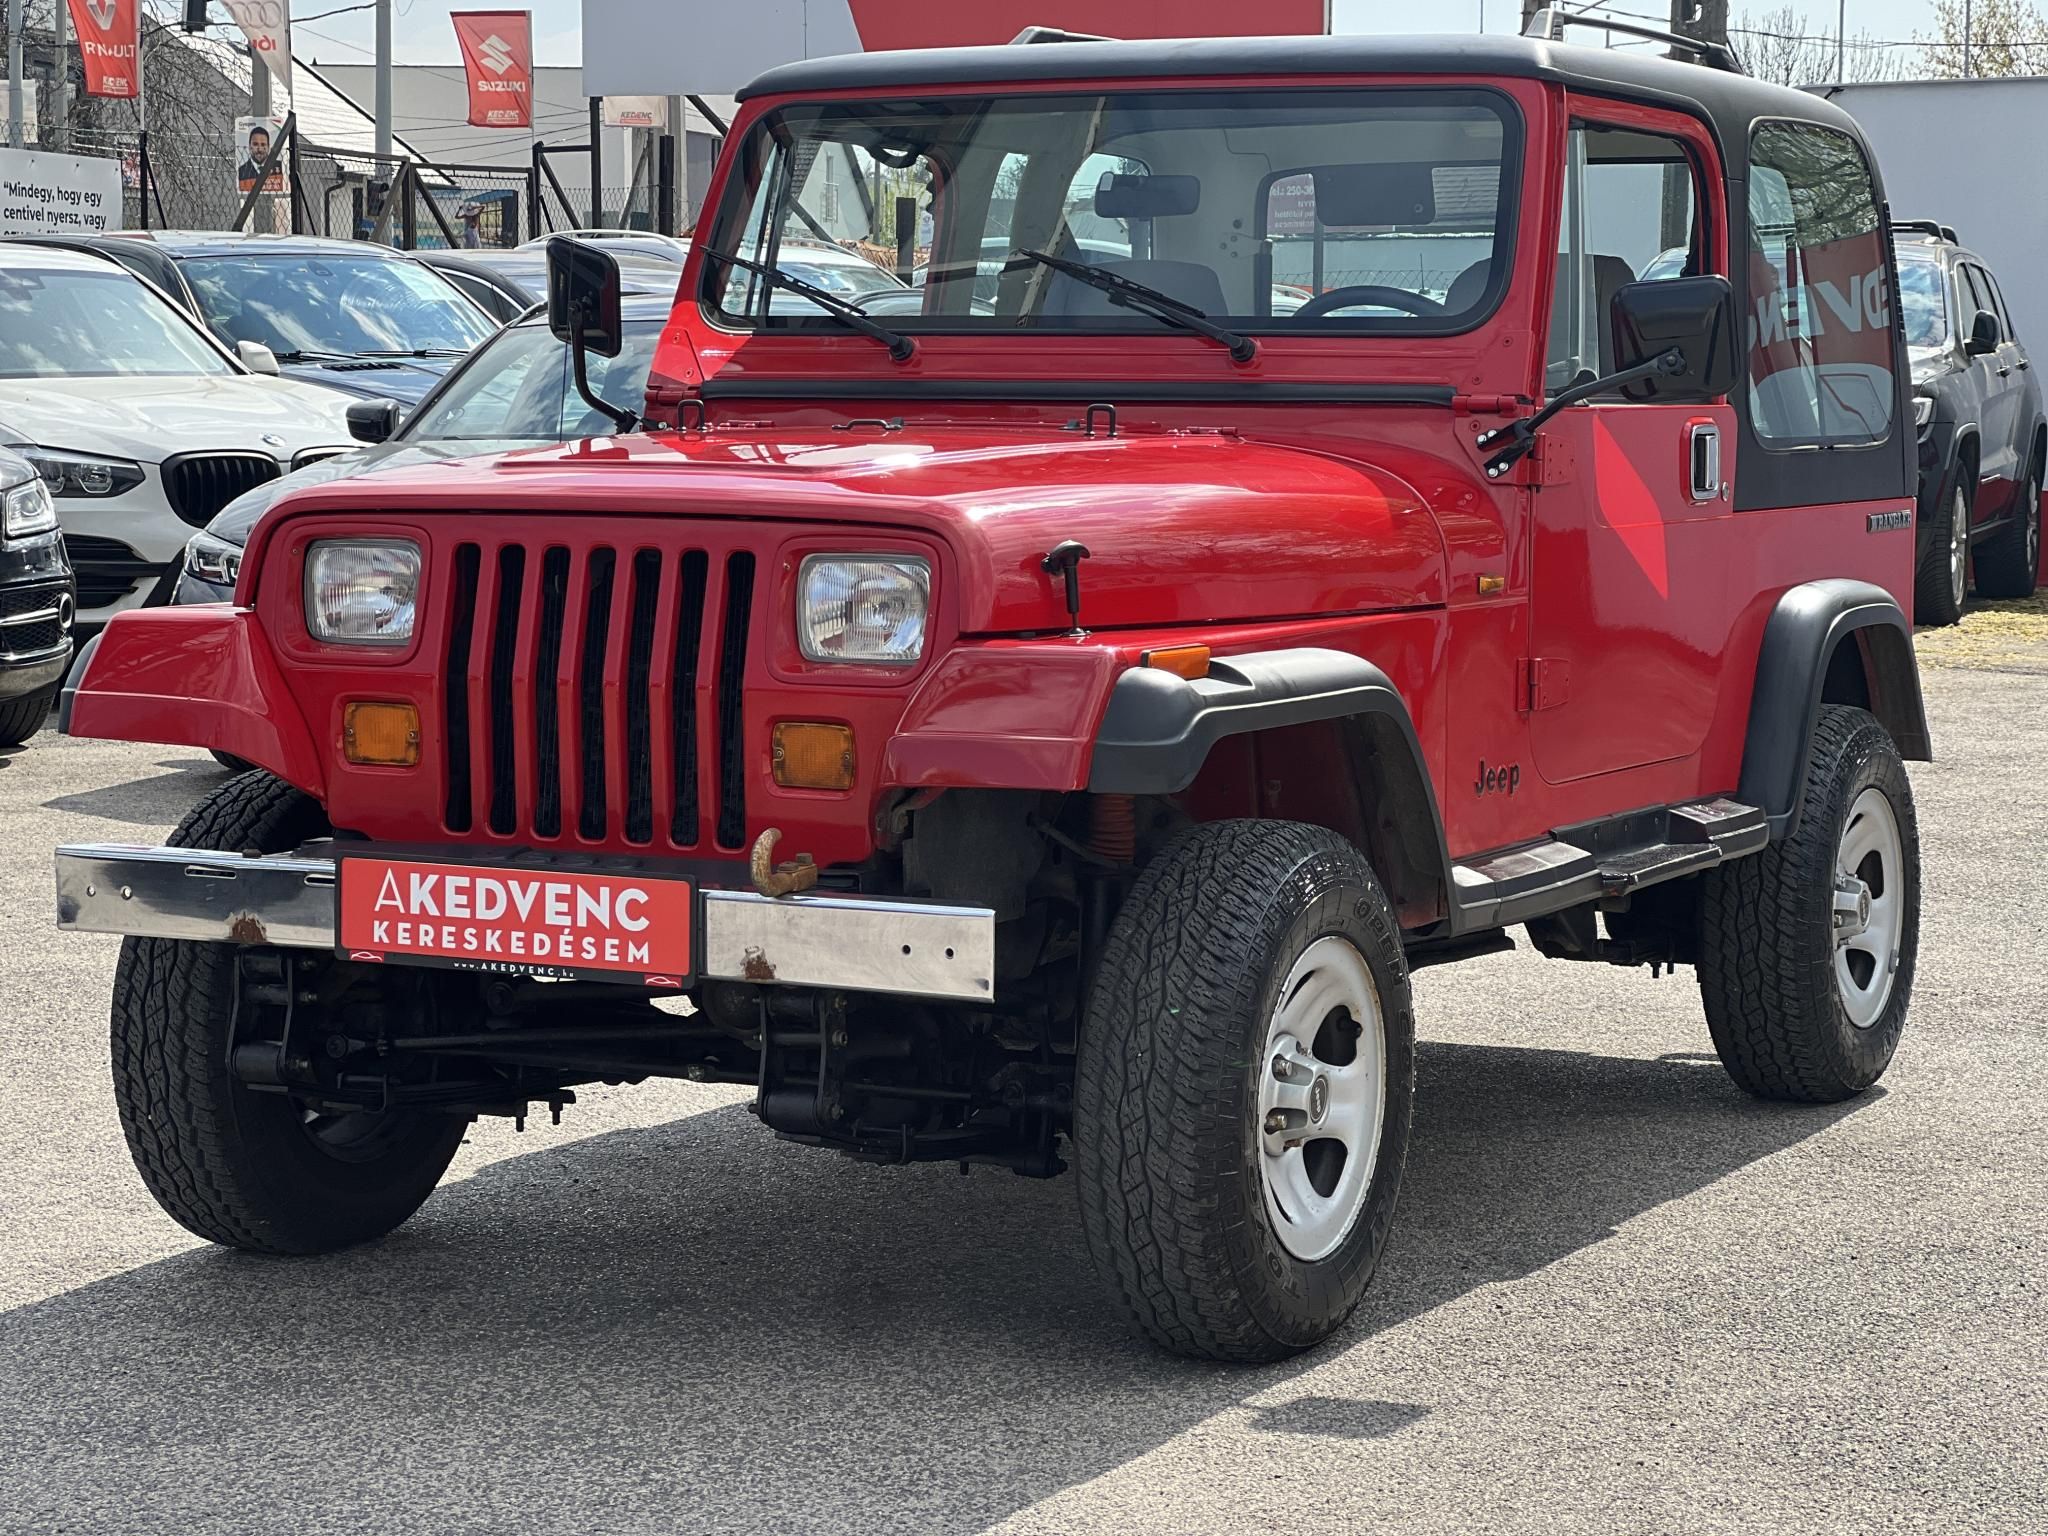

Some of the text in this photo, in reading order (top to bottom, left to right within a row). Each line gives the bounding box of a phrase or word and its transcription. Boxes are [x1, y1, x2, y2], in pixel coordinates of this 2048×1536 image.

[477, 80, 526, 93] SUZUKI
[57, 186, 82, 206] hogy
[83, 190, 102, 207] egy
[3, 205, 107, 231] centivel nyersz, vagy
[1474, 759, 1520, 795] Jeep
[372, 919, 650, 965] KERESKEDÉSEM
[453, 962, 575, 978] www.AKEDVENC.hu
